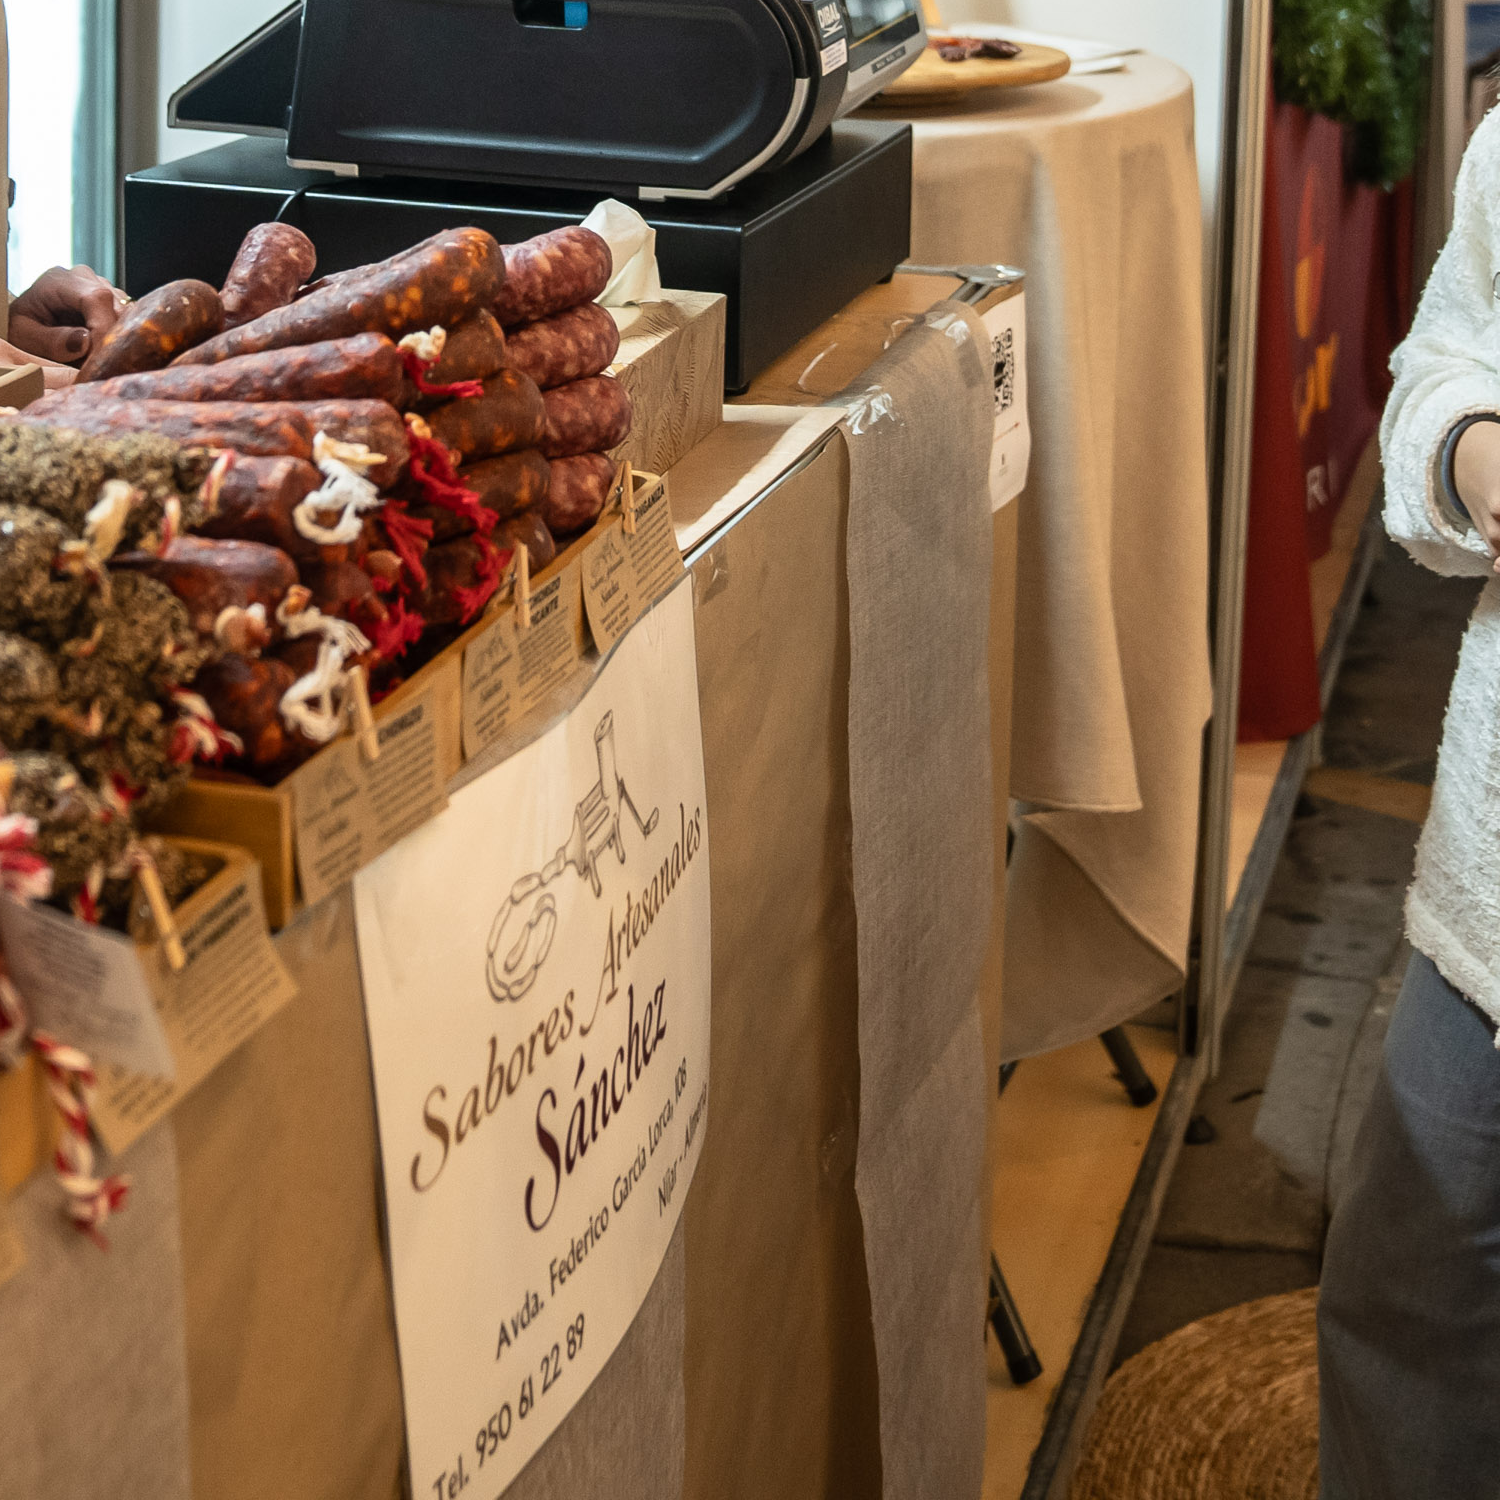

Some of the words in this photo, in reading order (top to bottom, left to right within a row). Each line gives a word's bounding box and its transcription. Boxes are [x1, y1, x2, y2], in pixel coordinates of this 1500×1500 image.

[817, 2, 841, 29] DIBAL
[410, 988, 575, 1193] Sabores
[579, 802, 701, 1037] Artesanales
[525, 978, 668, 1231] Sánchez
[496, 1290, 546, 1361] Avda.
[549, 1206, 609, 1297] Federico
[612, 1144, 647, 1213] García
[648, 1098, 674, 1157] Lorca,
[675, 1056, 687, 1104] 108
[432, 1453, 470, 1500] Tel.
[476, 1402, 512, 1468] 950
[519, 1374, 534, 1420] 61
[540, 1342, 562, 1395] 22
[566, 1312, 585, 1361] 89
